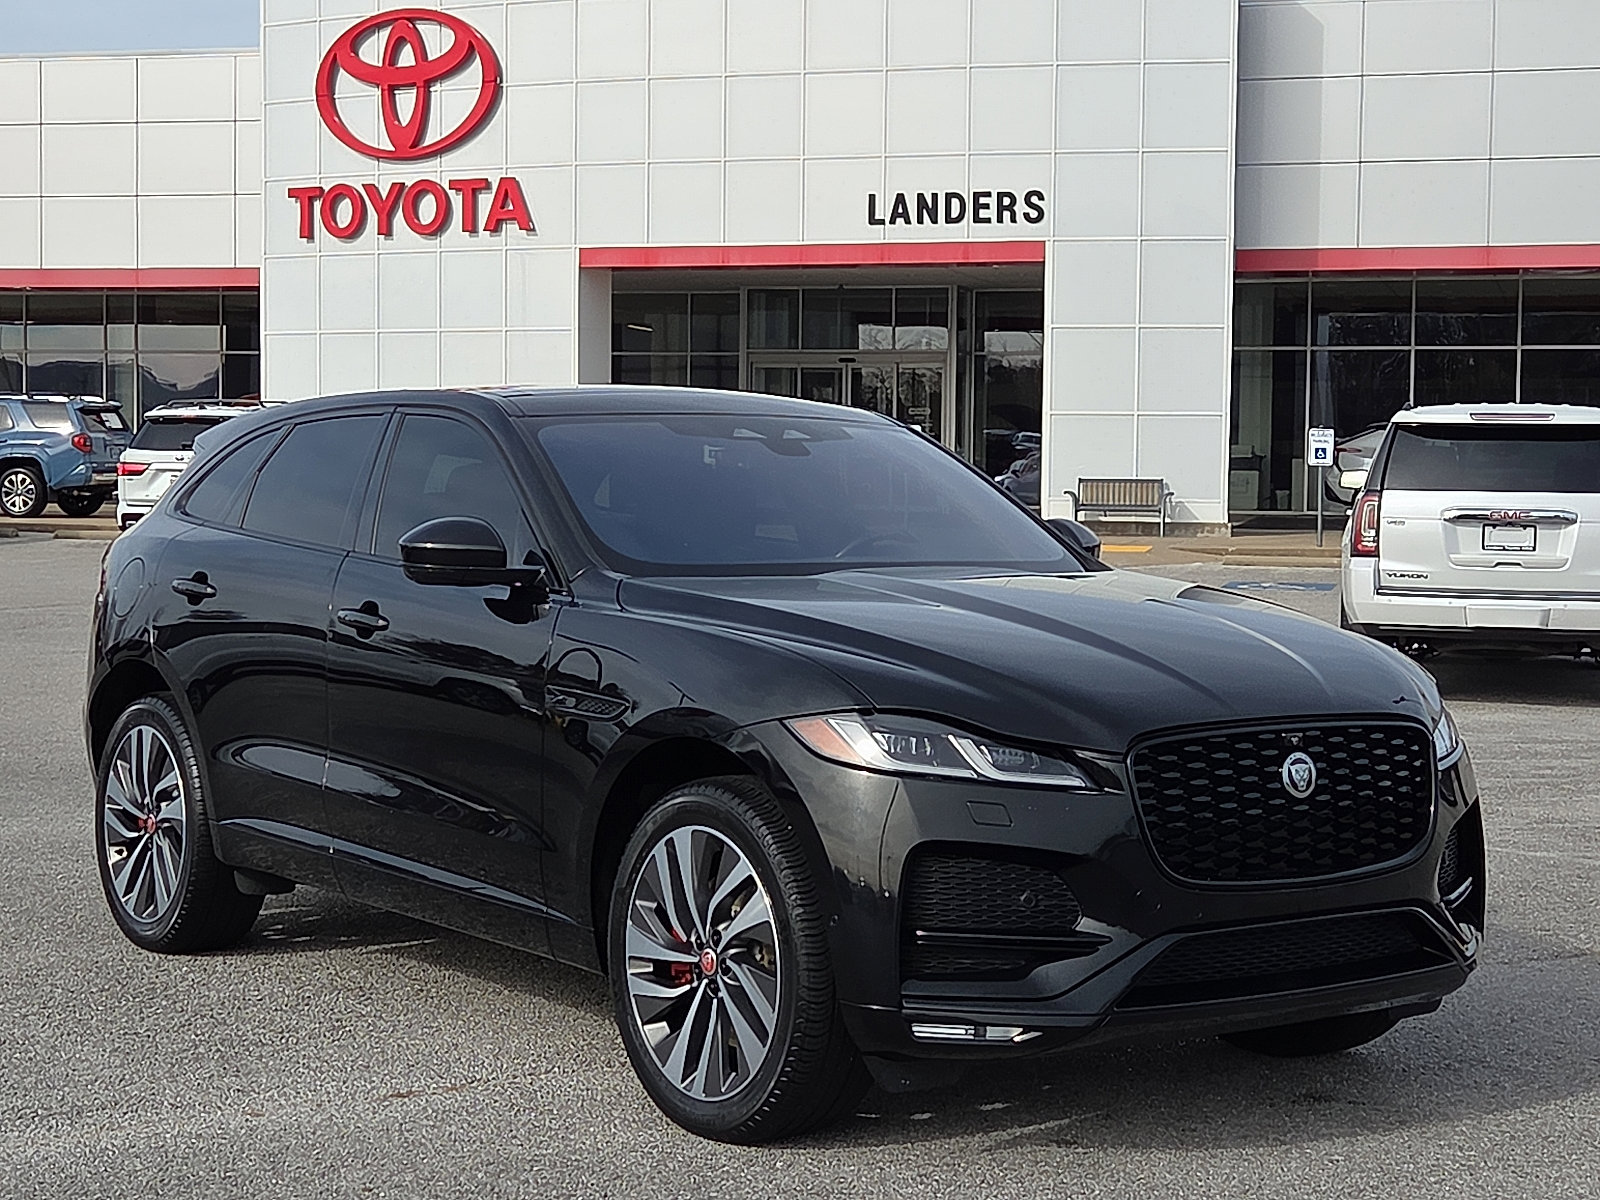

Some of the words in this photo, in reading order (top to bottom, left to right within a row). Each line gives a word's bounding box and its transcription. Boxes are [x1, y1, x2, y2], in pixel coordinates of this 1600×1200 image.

[288, 176, 535, 241] TOYOTA
[868, 190, 1045, 225] LANDERS
[1489, 510, 1531, 521] GMC
[1385, 572, 1429, 580] YUKON
